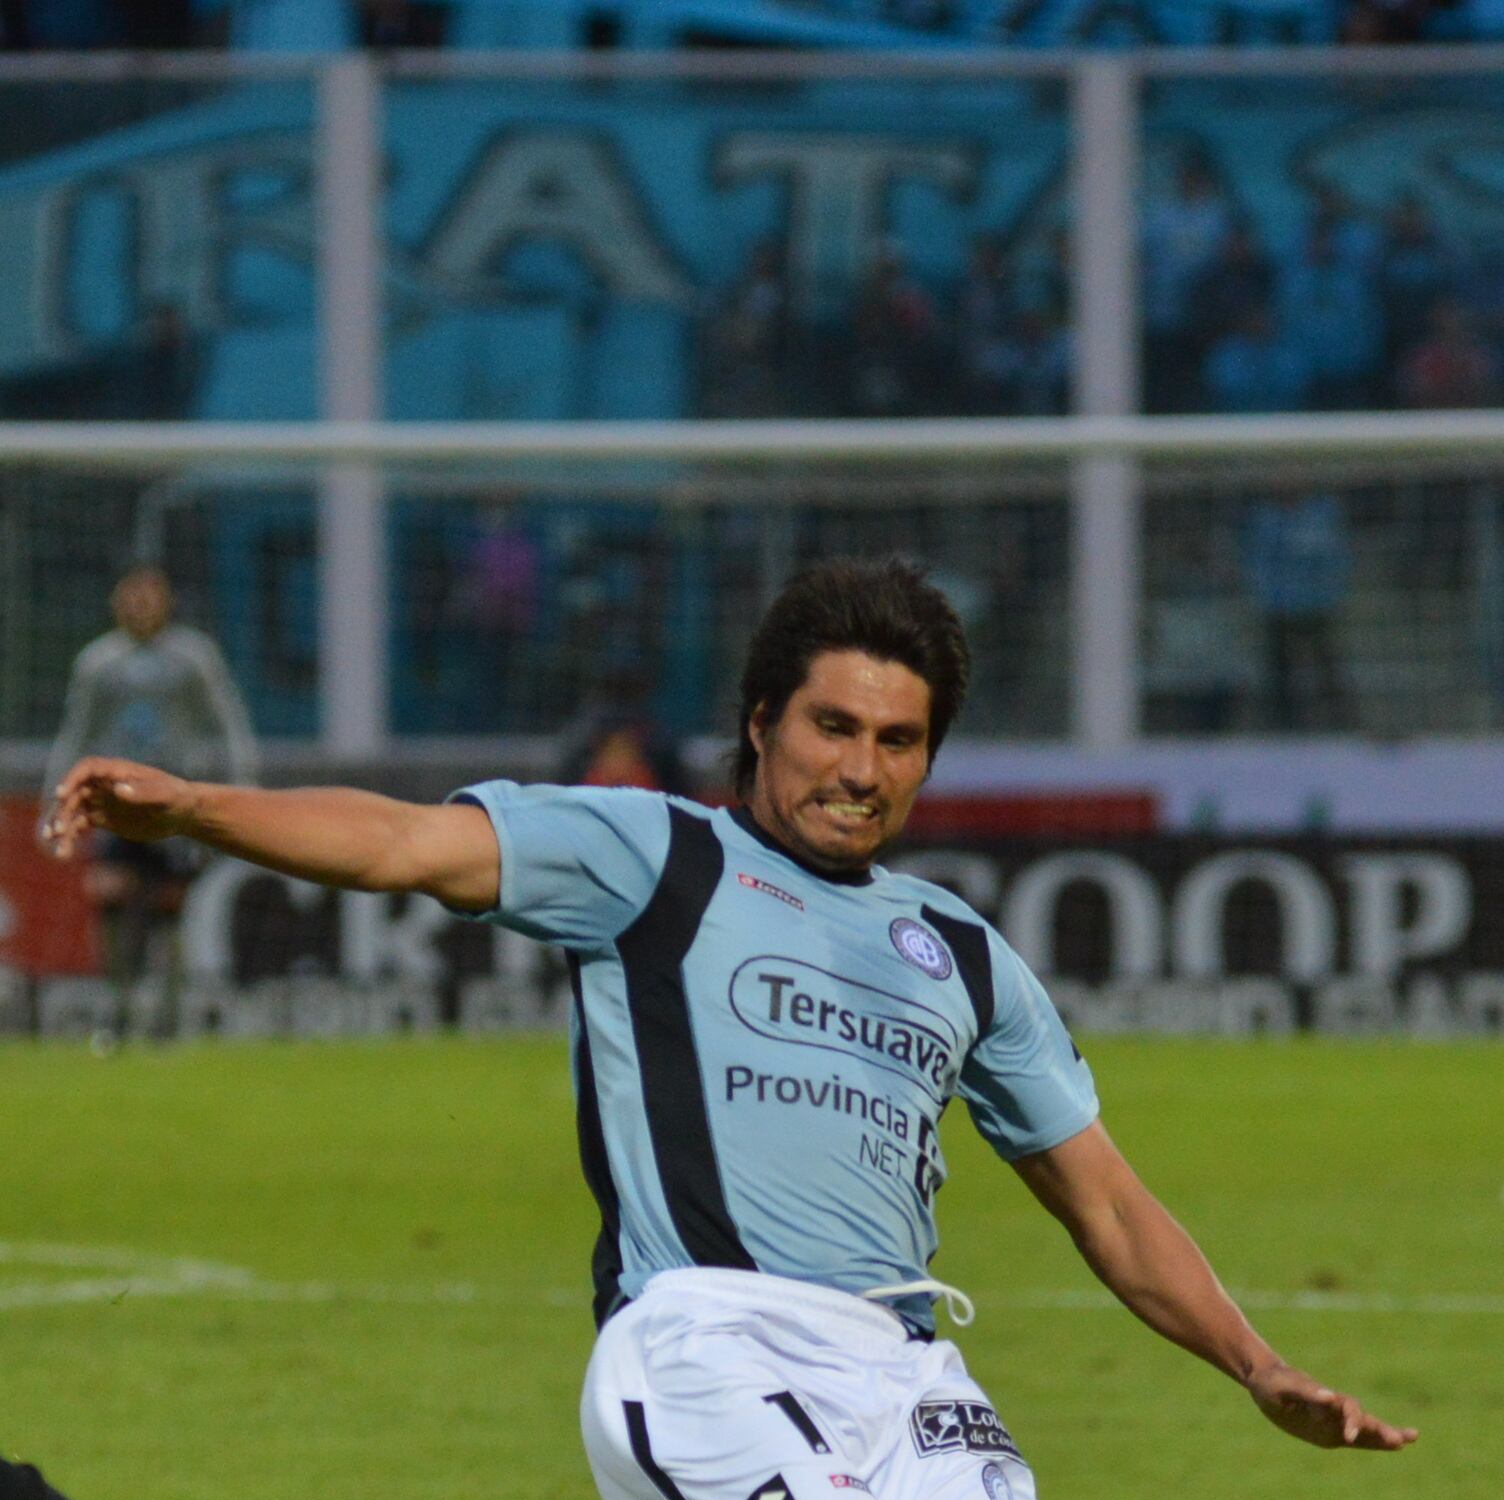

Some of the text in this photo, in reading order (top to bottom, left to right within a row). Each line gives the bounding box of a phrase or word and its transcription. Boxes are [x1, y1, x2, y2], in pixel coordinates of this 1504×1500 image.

[758, 973, 948, 1086] Tersuave
[725, 1065, 909, 1142] Provincia
[859, 1132, 913, 1178] NET
[969, 1429, 986, 1445] de
